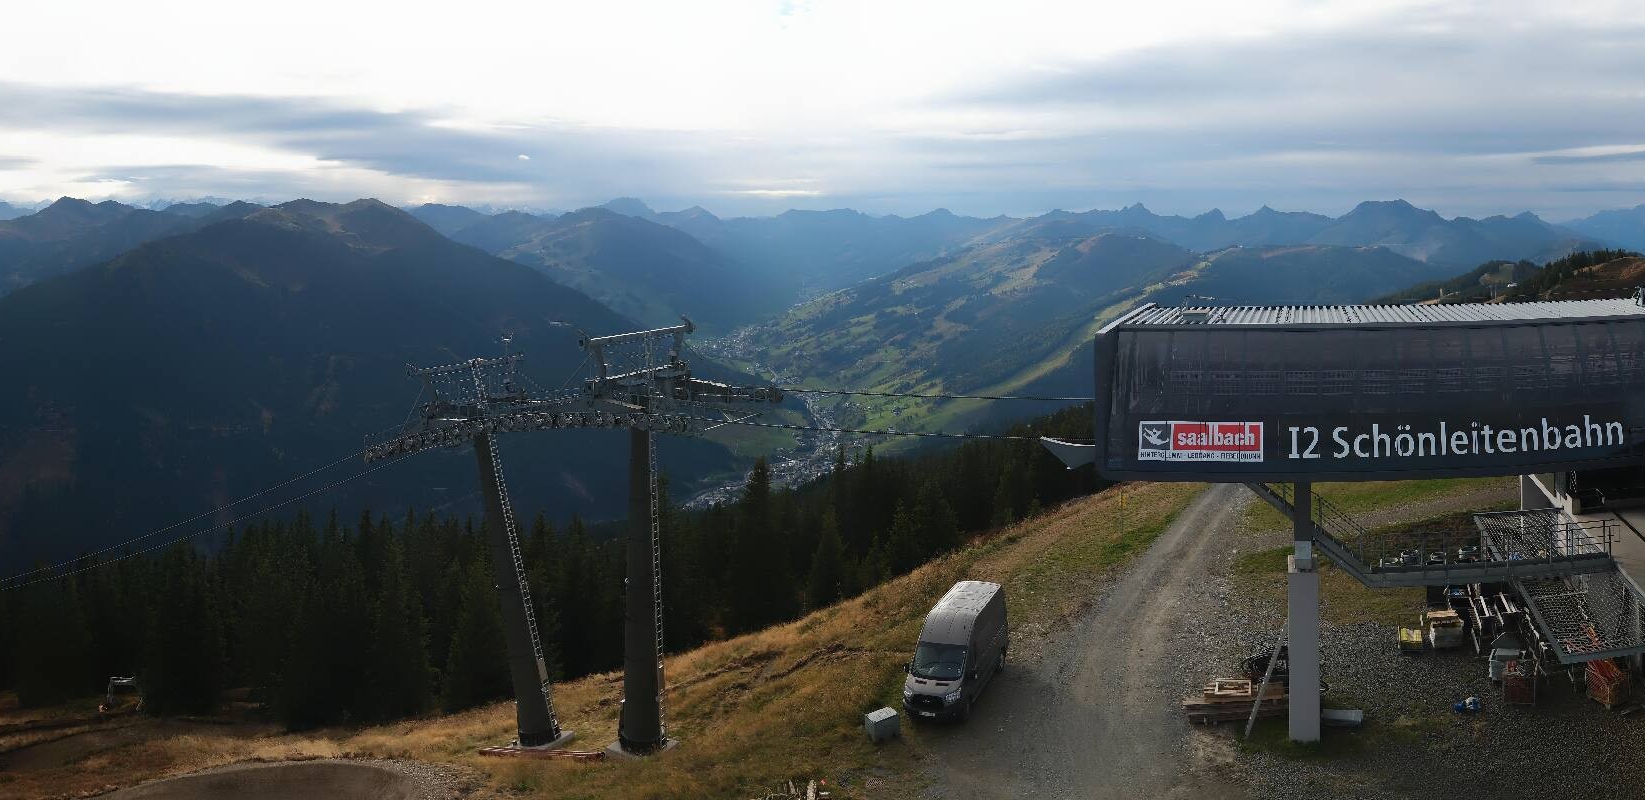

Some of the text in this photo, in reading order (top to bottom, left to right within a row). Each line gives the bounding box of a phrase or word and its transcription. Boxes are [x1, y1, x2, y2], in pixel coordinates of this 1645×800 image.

[1177, 423, 1255, 446] saalbach
[1288, 415, 1624, 459] I2 Schönleitenbahn
